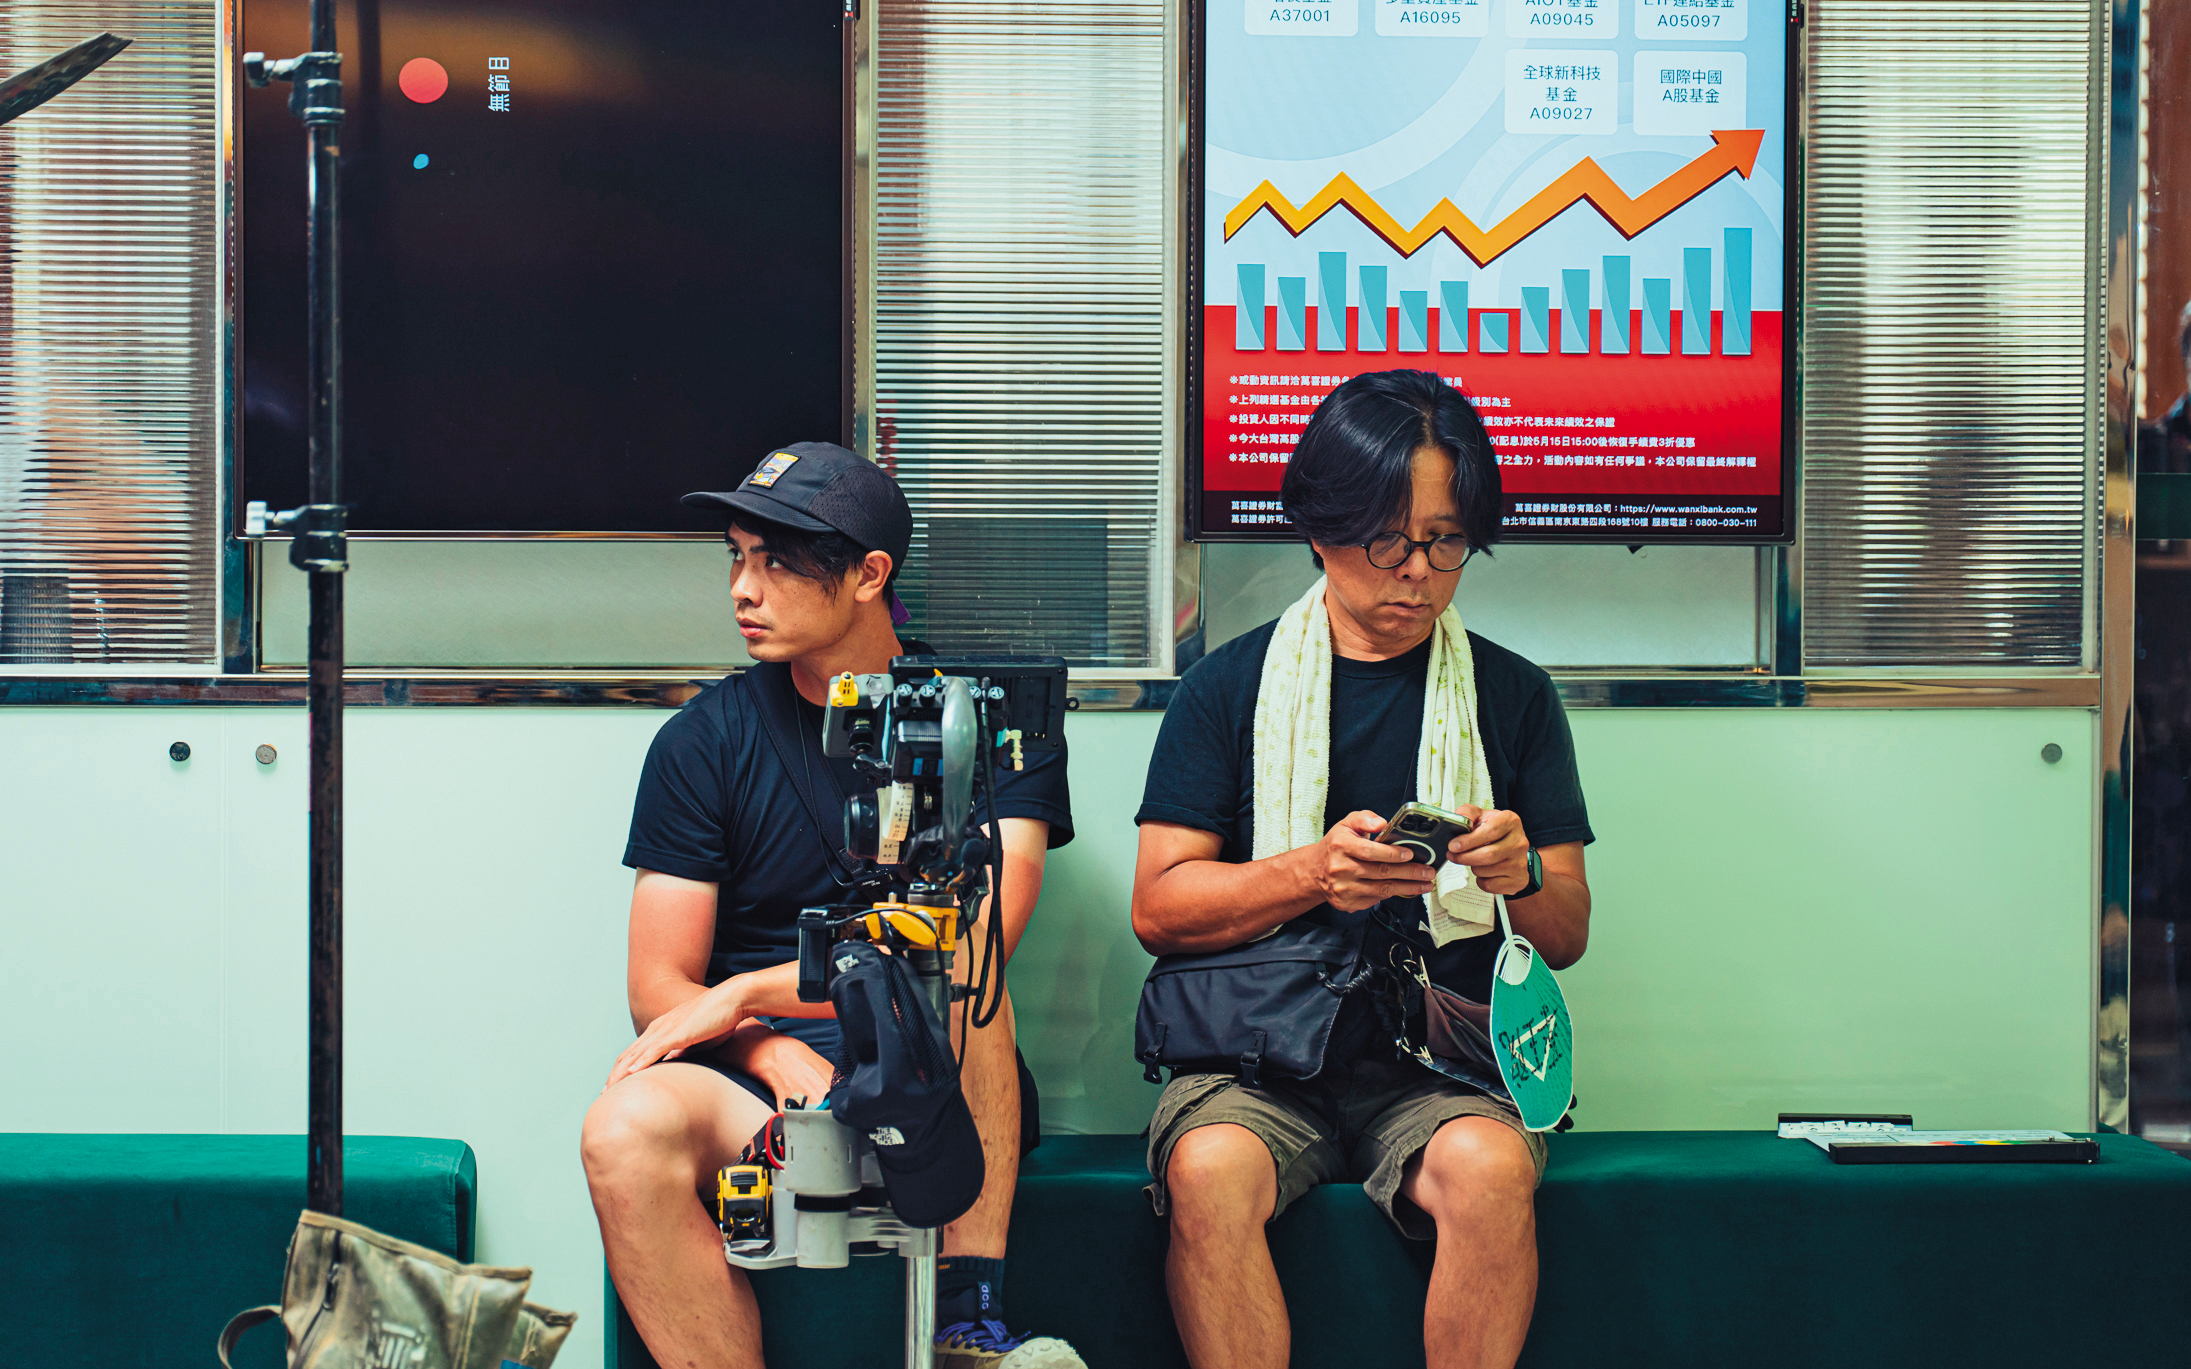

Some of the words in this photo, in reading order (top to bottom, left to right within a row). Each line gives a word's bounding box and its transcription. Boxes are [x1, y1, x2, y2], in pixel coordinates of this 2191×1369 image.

[1269, 9, 1330, 22] A37001
[1400, 11, 1461, 24] A16095
[1530, 13, 1594, 26] A09045
[1657, 14, 1721, 27] A05097
[1523, 64, 1601, 81] 全球新科技
[1660, 69, 1722, 85] 國際中國
[487, 56, 511, 112] 無節目
[1545, 86, 1578, 102] 基金
[1662, 88, 1720, 103] A股基金
[1529, 106, 1593, 120] A09027
